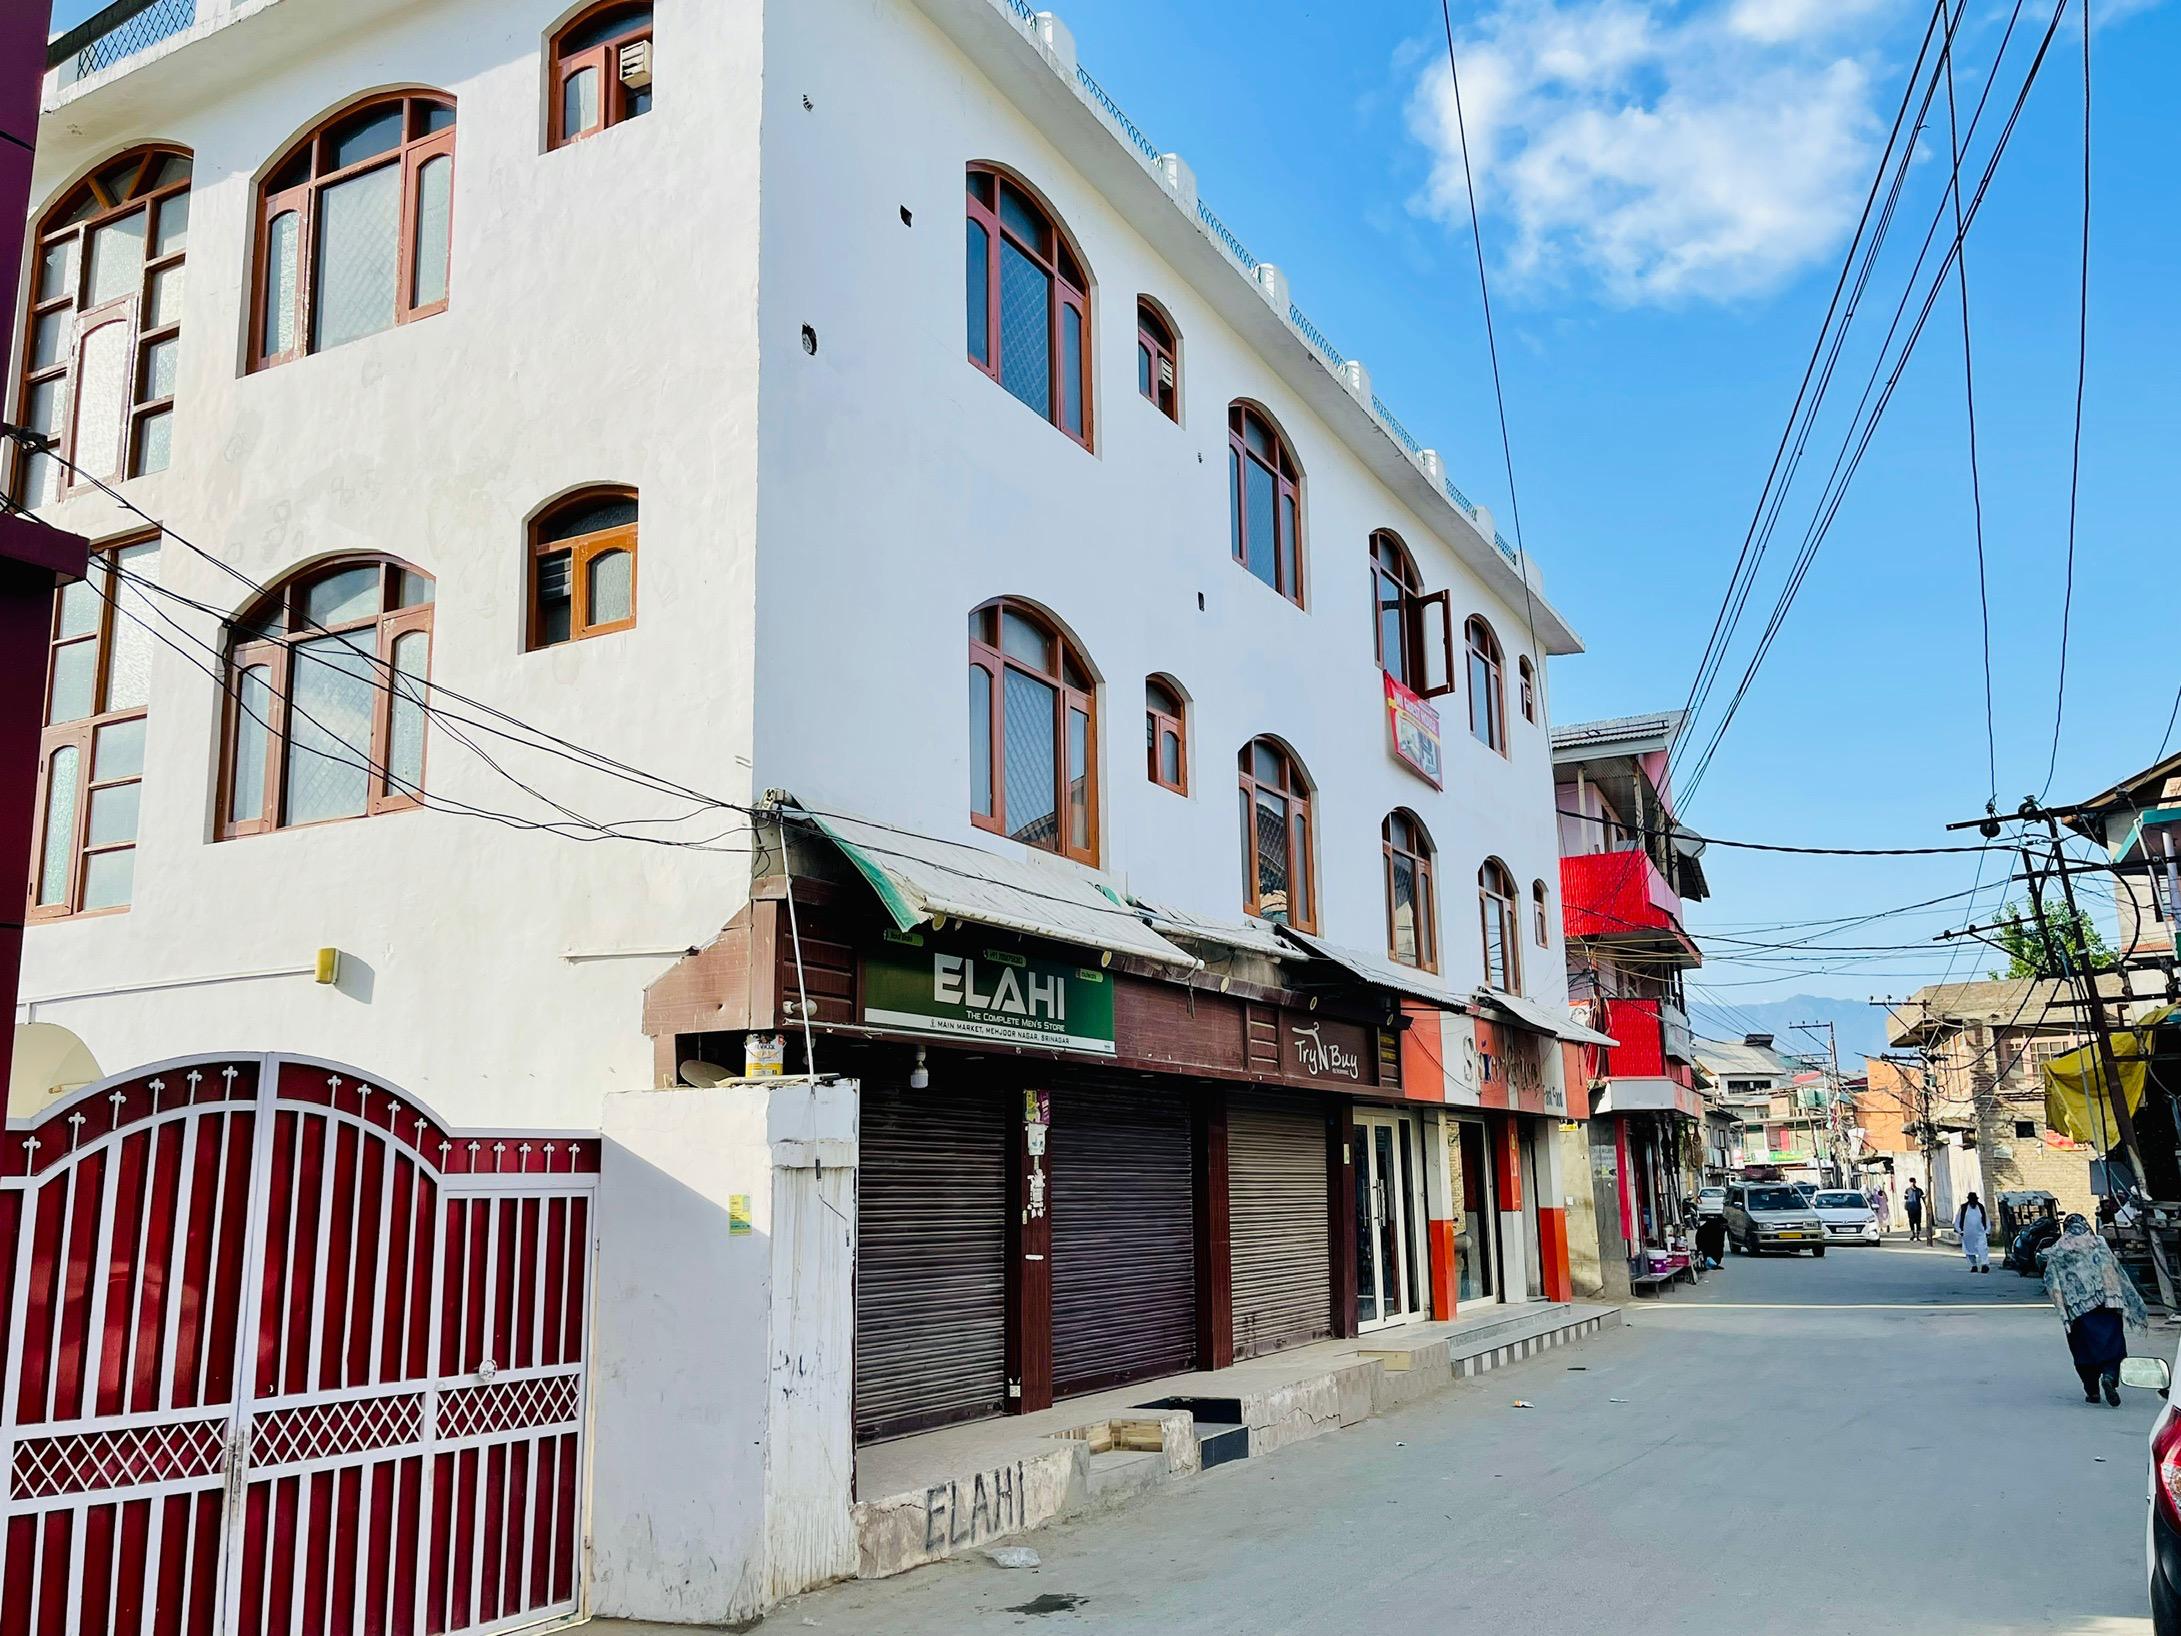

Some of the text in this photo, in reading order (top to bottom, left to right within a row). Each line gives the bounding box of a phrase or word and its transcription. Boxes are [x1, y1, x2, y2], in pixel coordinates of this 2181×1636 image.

[934, 953, 1064, 1020] ELAHI
[937, 1021, 955, 1029] MAIN
[956, 1023, 984, 1034] MARKET,
[1040, 1035, 1070, 1045] SRINAGAR
[1294, 1040, 1318, 1075] Try
[1329, 1044, 1359, 1079] Buy
[926, 1460, 1024, 1551] ELAHI
